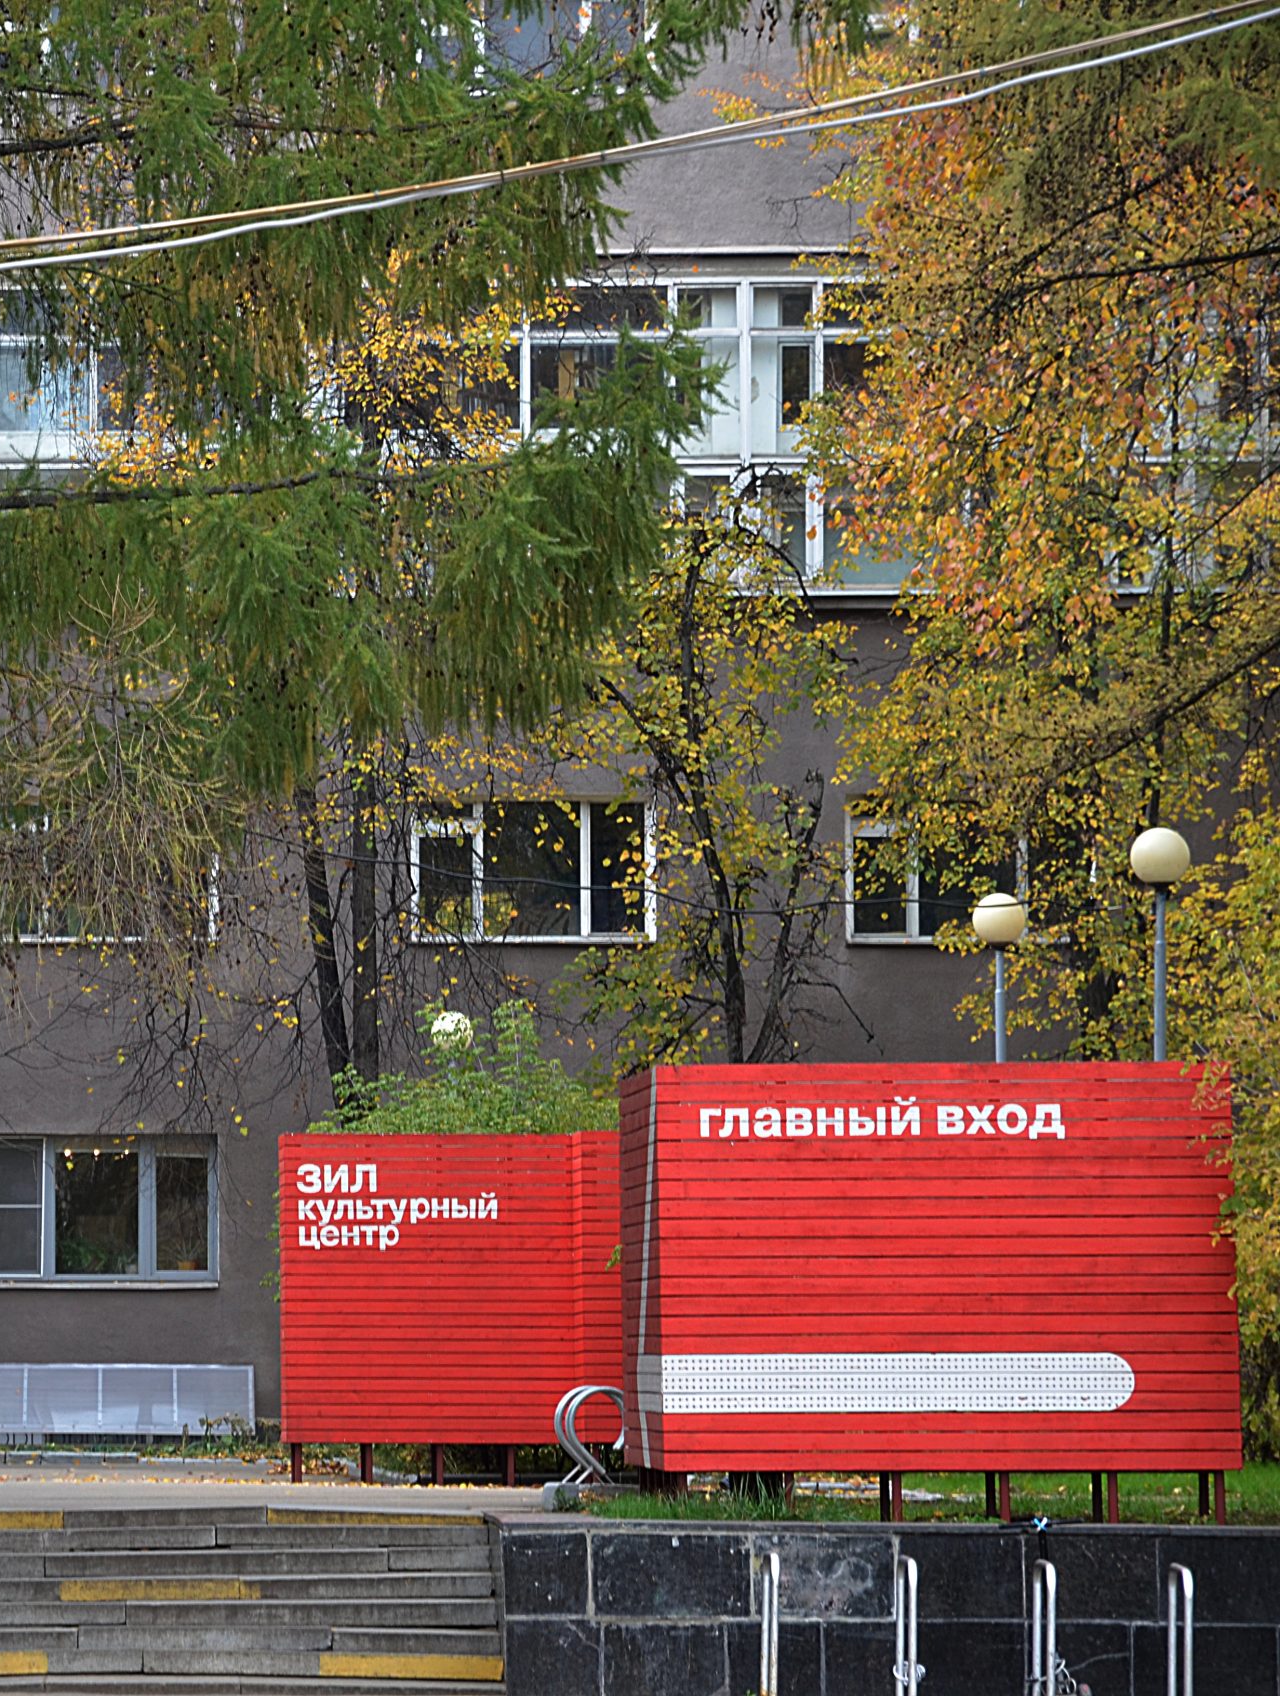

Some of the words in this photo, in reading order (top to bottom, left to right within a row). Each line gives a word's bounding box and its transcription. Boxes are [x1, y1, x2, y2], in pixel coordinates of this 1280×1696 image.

[699, 1096, 920, 1138] главный
[936, 1103, 1066, 1140] вход
[296, 1163, 378, 1194] ЗИЛ
[297, 1192, 498, 1226] культурный
[298, 1224, 400, 1251] центр
